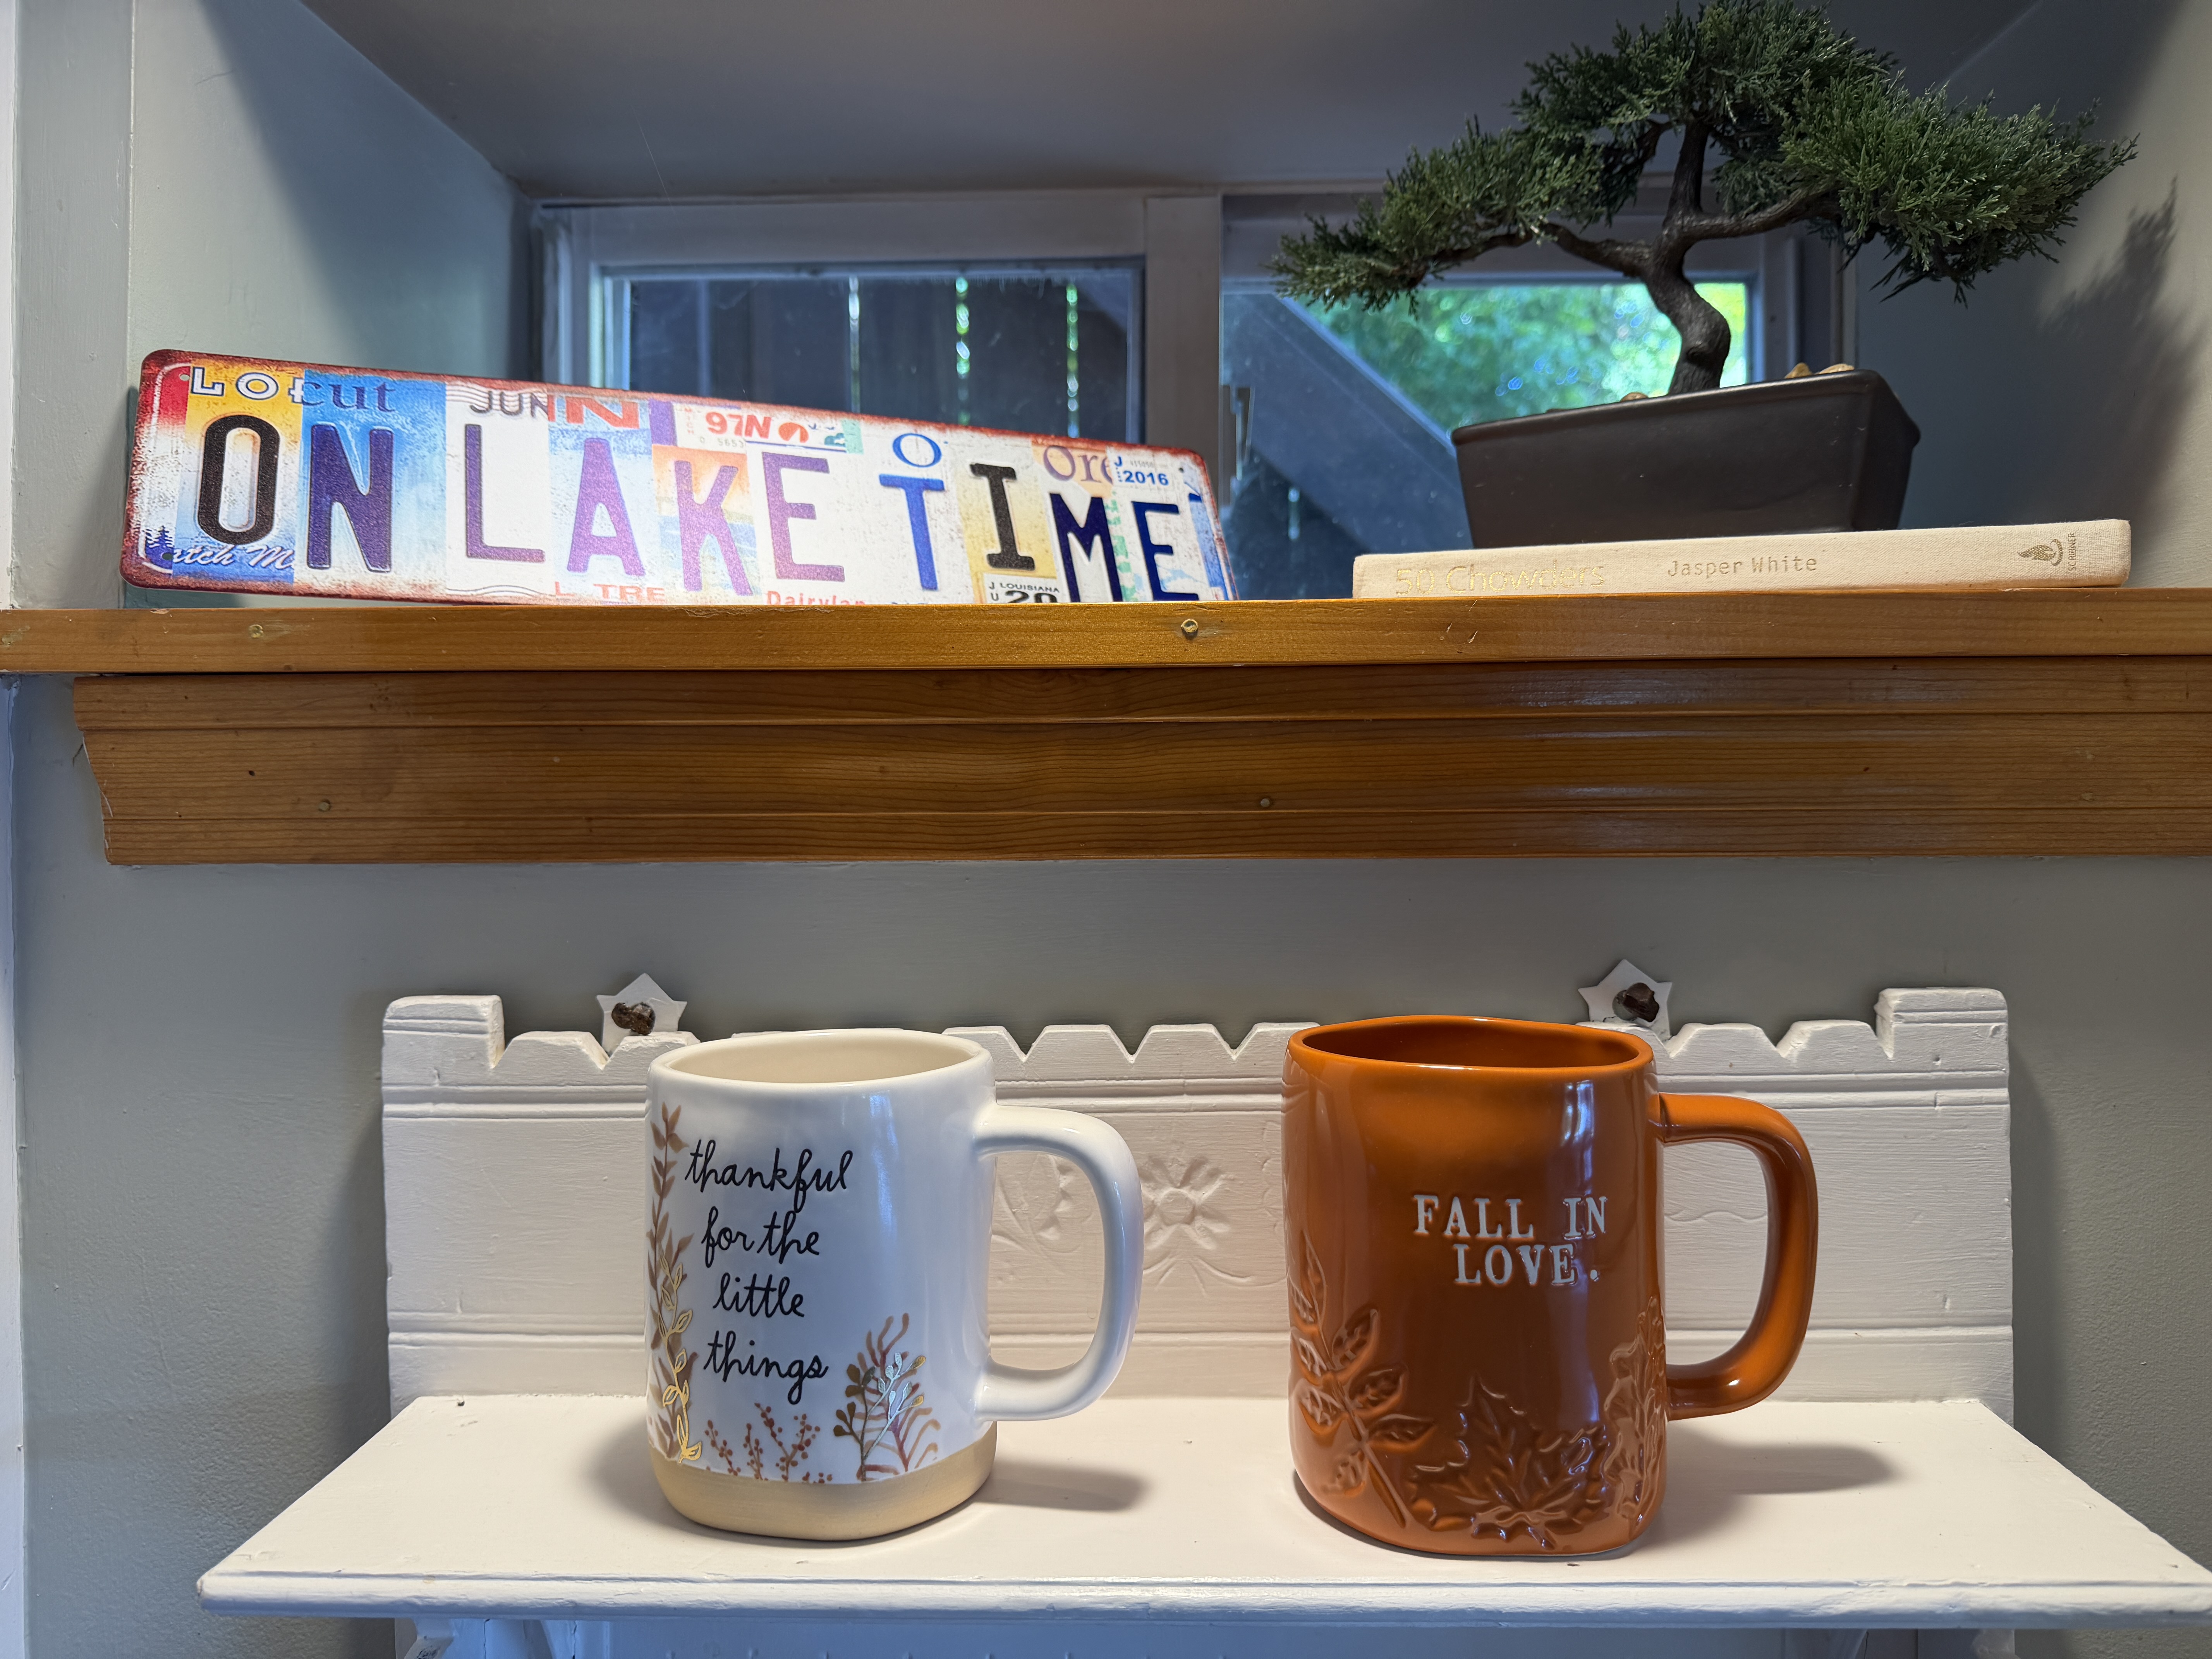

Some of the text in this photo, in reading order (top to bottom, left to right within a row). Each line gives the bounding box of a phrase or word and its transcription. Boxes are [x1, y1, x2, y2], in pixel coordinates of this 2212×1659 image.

[1123, 471, 1169, 486] 2016
[197, 414, 1199, 602] ON LAKE TIME
[1668, 555, 1817, 579] Jasper White
[2068, 532, 2076, 572] SCRIBNER
[1000, 582, 1060, 593] LOUISIANA
[1396, 560, 1604, 595] 50 Chowders
[685, 1139, 853, 1213] thankful
[701, 1206, 820, 1268] for the
[1413, 1194, 1608, 1240] FALL IN
[1452, 1243, 1599, 1286] LOVE.
[713, 1273, 805, 1317] little
[703, 1330, 829, 1405] things
